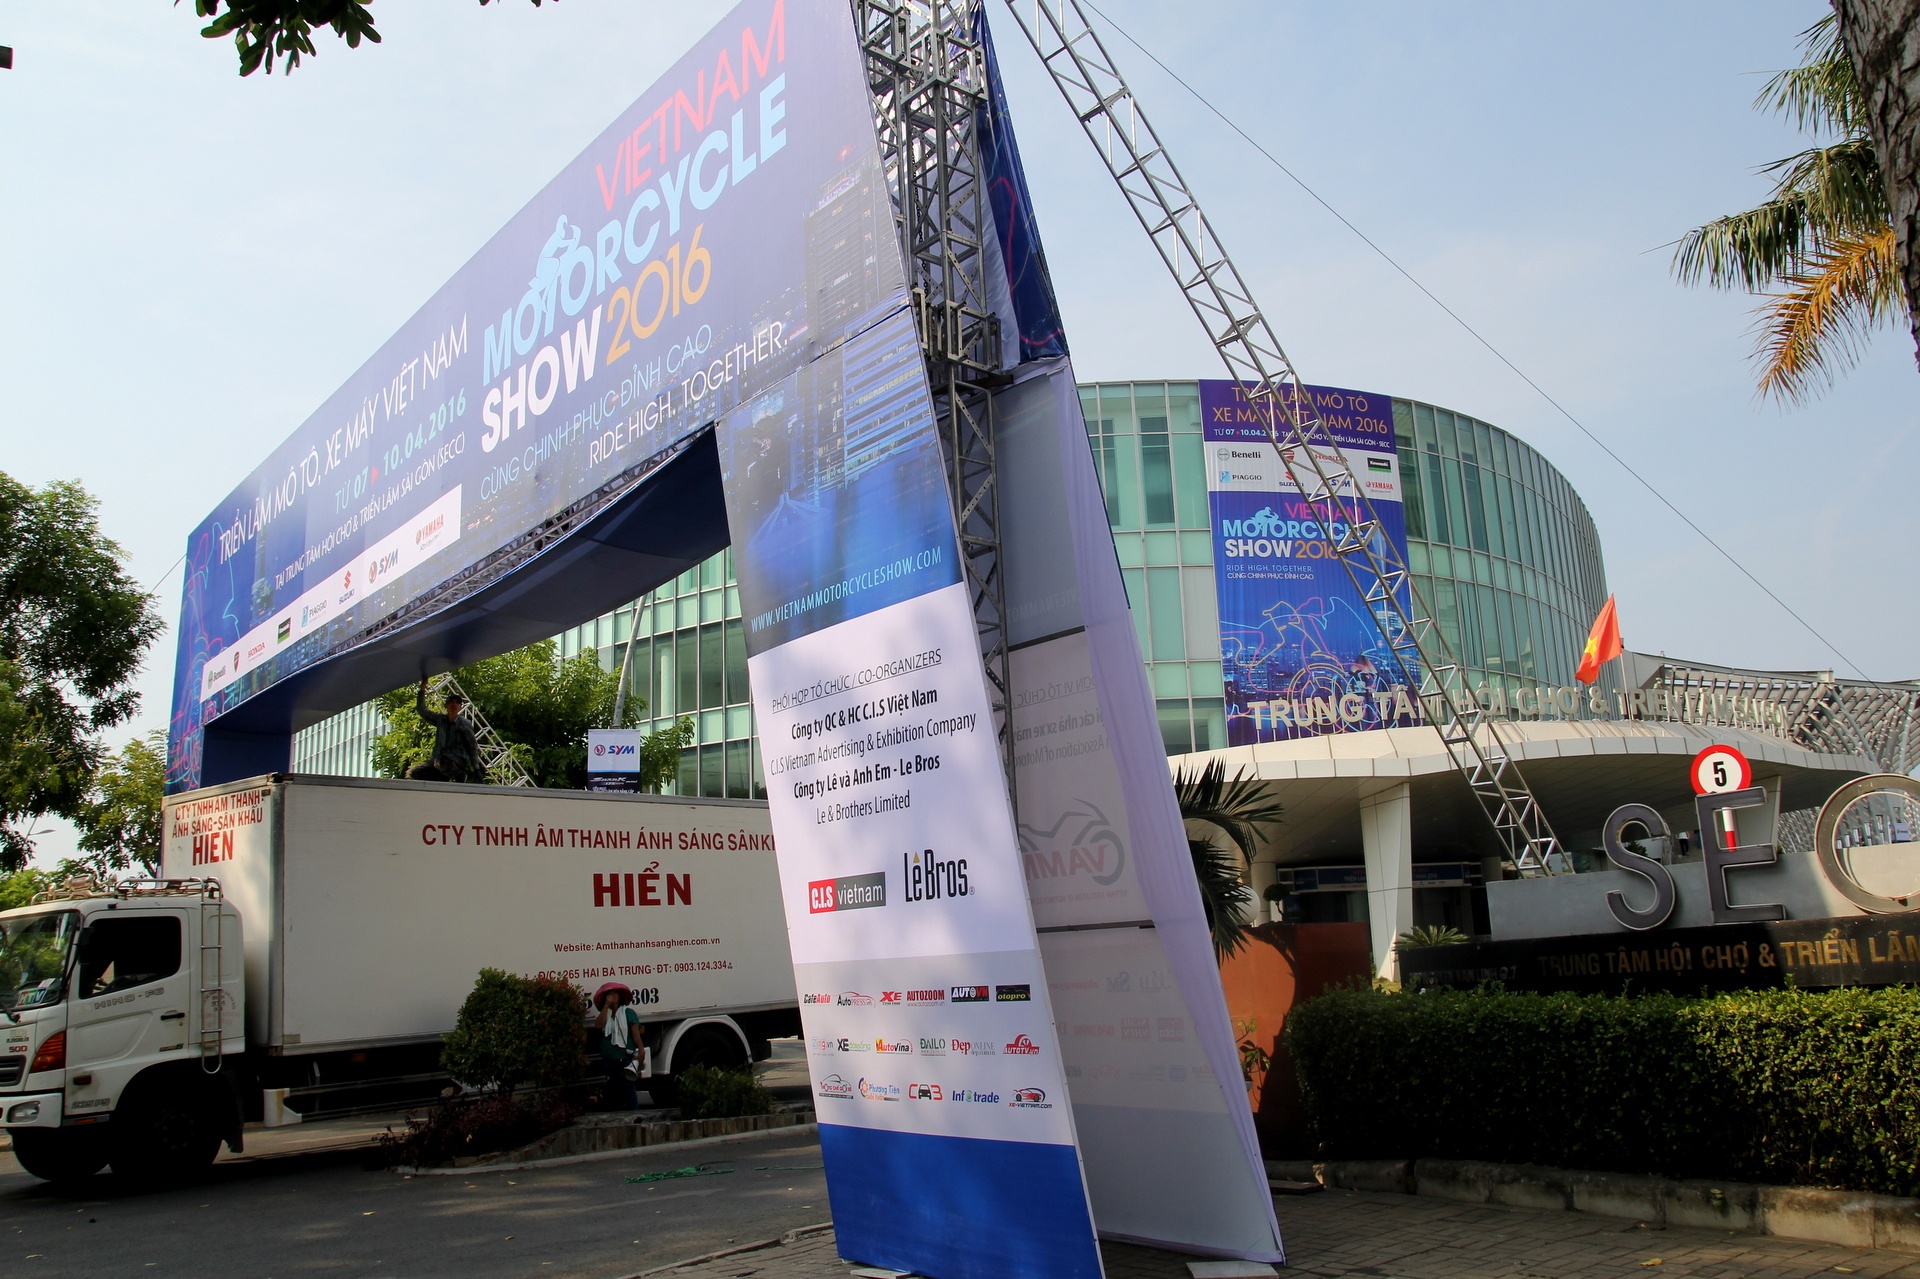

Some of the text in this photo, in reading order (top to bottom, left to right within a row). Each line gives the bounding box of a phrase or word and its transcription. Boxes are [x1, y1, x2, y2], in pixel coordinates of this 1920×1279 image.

[595, 0, 785, 211] VIETNAM
[483, 71, 787, 387] MOTORCYCLE
[481, 223, 711, 453] SHOW 2016
[589, 321, 788, 469] RIDE HIGH. TOGETHER.
[1317, 393, 1368, 412] MÔ TÔ
[480, 324, 712, 500] CÙNG CHINH PHỤC ĐỈNH CAO
[1213, 407, 1231, 422] XE
[1355, 417, 1388, 435] 2016
[220, 312, 467, 564] TRIỂN LÃM MÔ TÔ, XE MÁY VIỆT NAM
[354, 466, 369, 499] 07
[383, 387, 466, 476] 10.04.2016
[437, 431, 465, 470] (SECC)
[1231, 451, 1261, 459] Benelli
[1372, 482, 1393, 490] YAMAHA
[1284, 502, 1362, 522] VIETNAM
[1225, 539, 1292, 558] SHOW
[751, 546, 942, 633] WWW.VIETNAMMOTORCYCLESHOW.COM
[858, 649, 942, 684] CO-ORGANIZERS
[792, 688, 937, 740] Công ty QC & HC C.I.S Việt Nam
[1247, 693, 1365, 730] TRUNG
[1589, 686, 1610, 715] &
[608, 745, 634, 755] SYM
[785, 751, 816, 771] Vietnam
[818, 739, 865, 764] Advertising
[867, 733, 875, 751] &
[876, 724, 924, 751] Exhibition
[926, 713, 976, 738] Company
[794, 782, 814, 800] Công
[816, 779, 825, 797] ty
[827, 773, 838, 792] Lê
[839, 771, 850, 789] và
[853, 766, 873, 786] Anh
[875, 763, 891, 781] Em
[900, 758, 913, 776] Le
[915, 754, 940, 773] Bros
[1713, 761, 1728, 787] 5
[175, 803, 191, 821] CTY
[817, 790, 911, 825] Le & Brothers Limited
[422, 823, 759, 851] CTY TNHH ÂM THANH ÁNH SÁNG SÂN
[593, 861, 692, 908] HIỂN
[811, 883, 883, 910] C.I.S vietnam
[554, 943, 595, 953] Website:
[1605, 946, 1650, 973] TÂM
[1655, 942, 1692, 976] HỘI
[1701, 940, 1749, 974] CHỢ
[1759, 943, 1776, 967] &
[1780, 928, 1859, 966] TRIỂN
[583, 967, 600, 978] HAI
[95, 994, 135, 1010] HINO
[880, 991, 902, 1003] XE
[906, 989, 945, 1001] AUTOZOOM
[9, 1045, 28, 1053] 500
